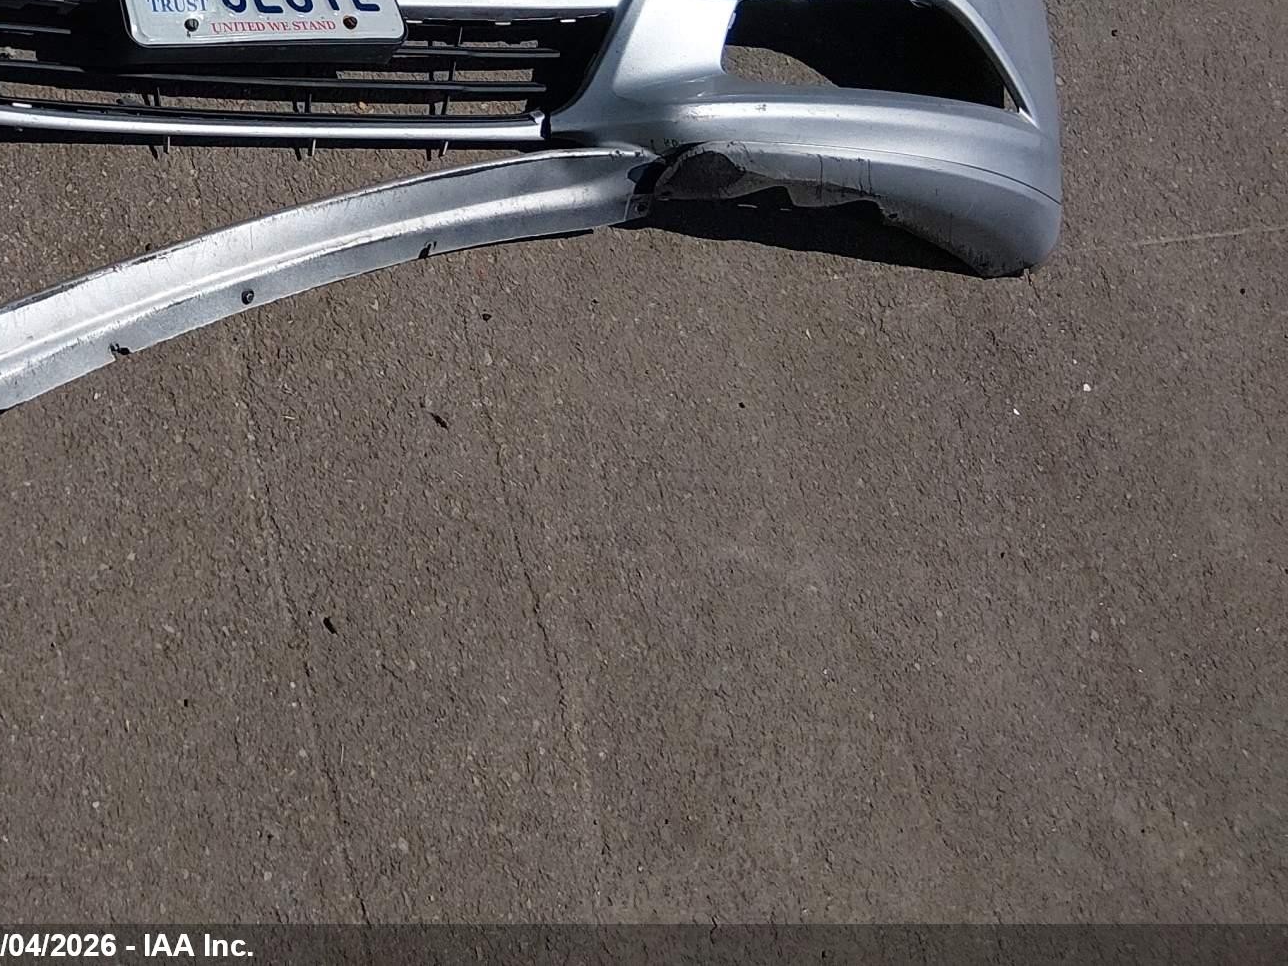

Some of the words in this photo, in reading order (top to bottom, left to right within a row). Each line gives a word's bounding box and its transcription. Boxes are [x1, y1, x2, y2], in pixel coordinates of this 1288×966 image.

[212, 21, 268, 34] UNITED
[269, 21, 293, 32] WE
[294, 20, 336, 31] STAND
